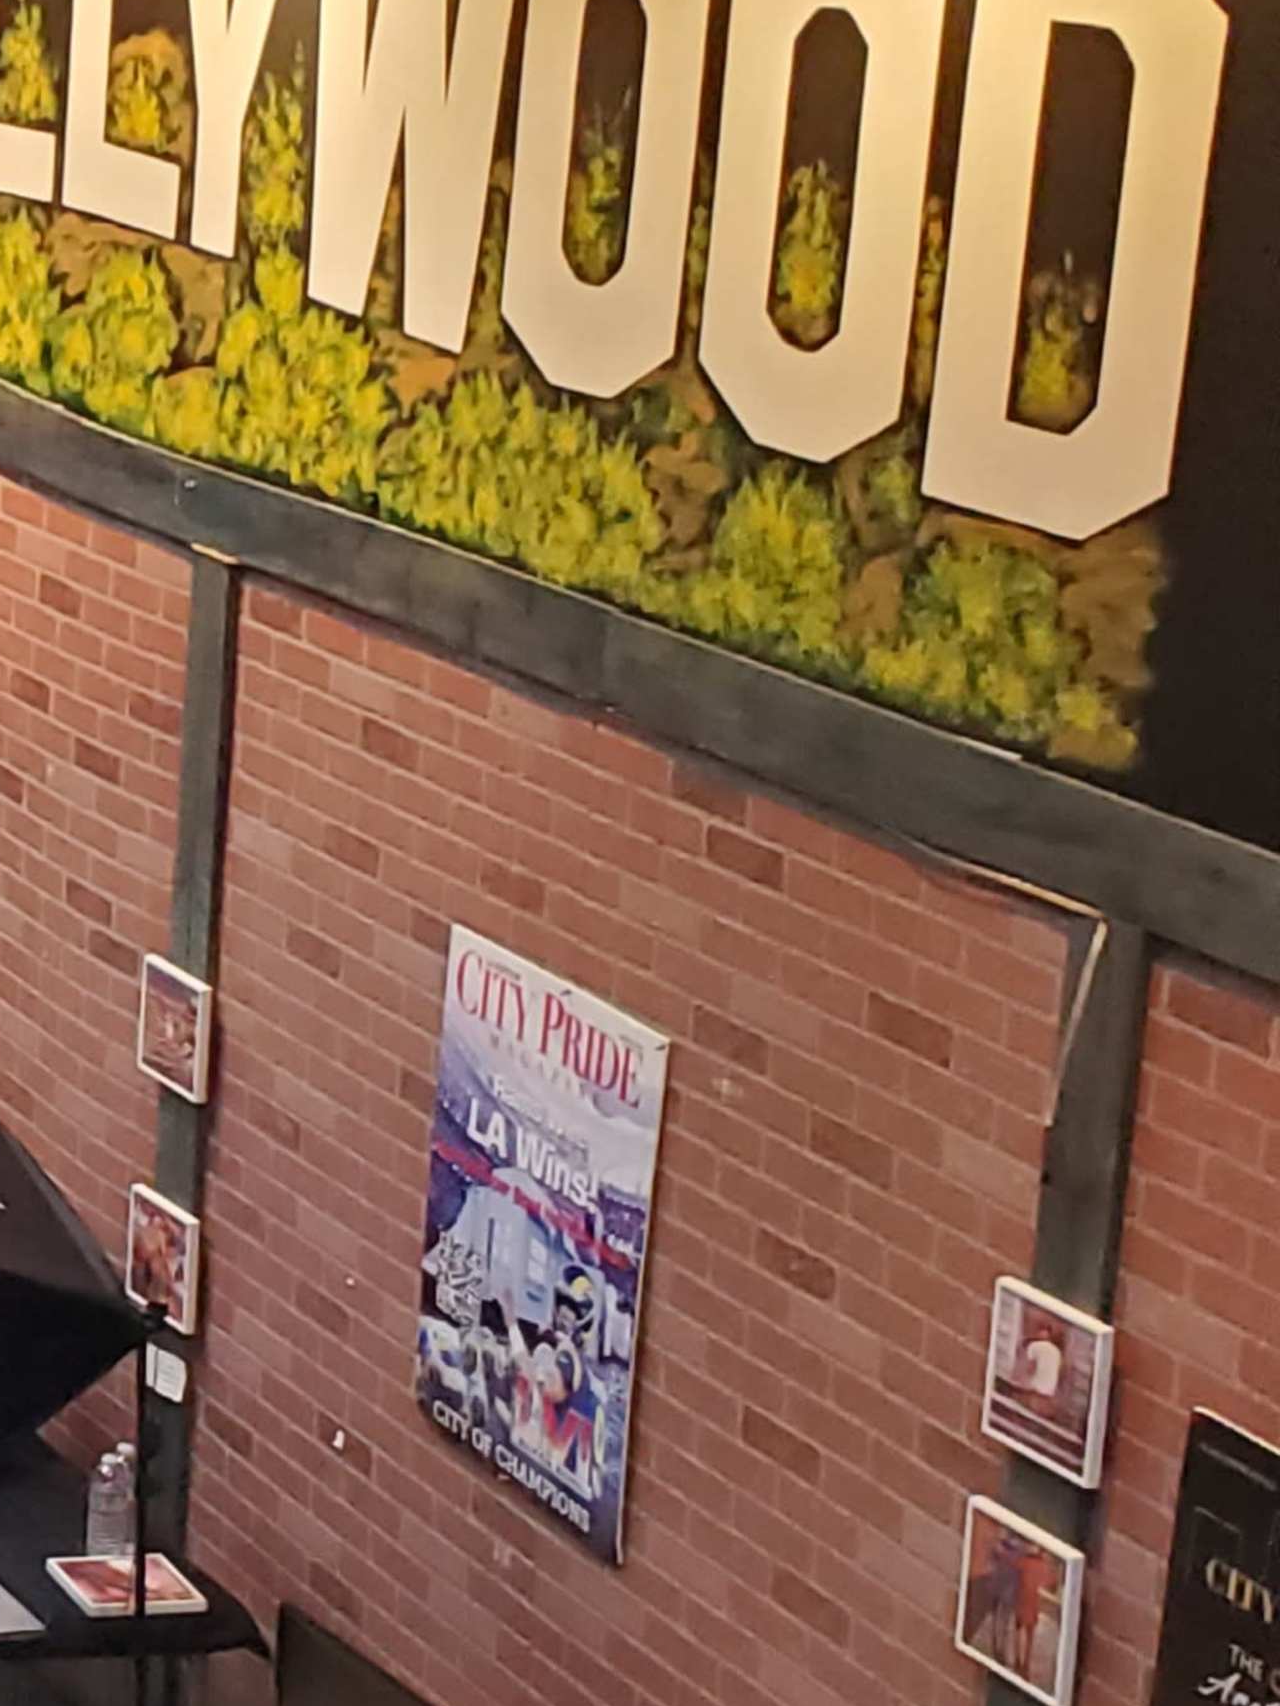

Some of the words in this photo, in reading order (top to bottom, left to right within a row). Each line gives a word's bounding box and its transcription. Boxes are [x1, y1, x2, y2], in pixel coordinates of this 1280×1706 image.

[456, 949, 524, 1043] CITY
[538, 992, 640, 1110] PRIDE
[466, 1097, 507, 1159] LA
[516, 1126, 600, 1214] Wins!
[432, 1399, 469, 1441] CITY
[1229, 1642, 1264, 1682] THE
